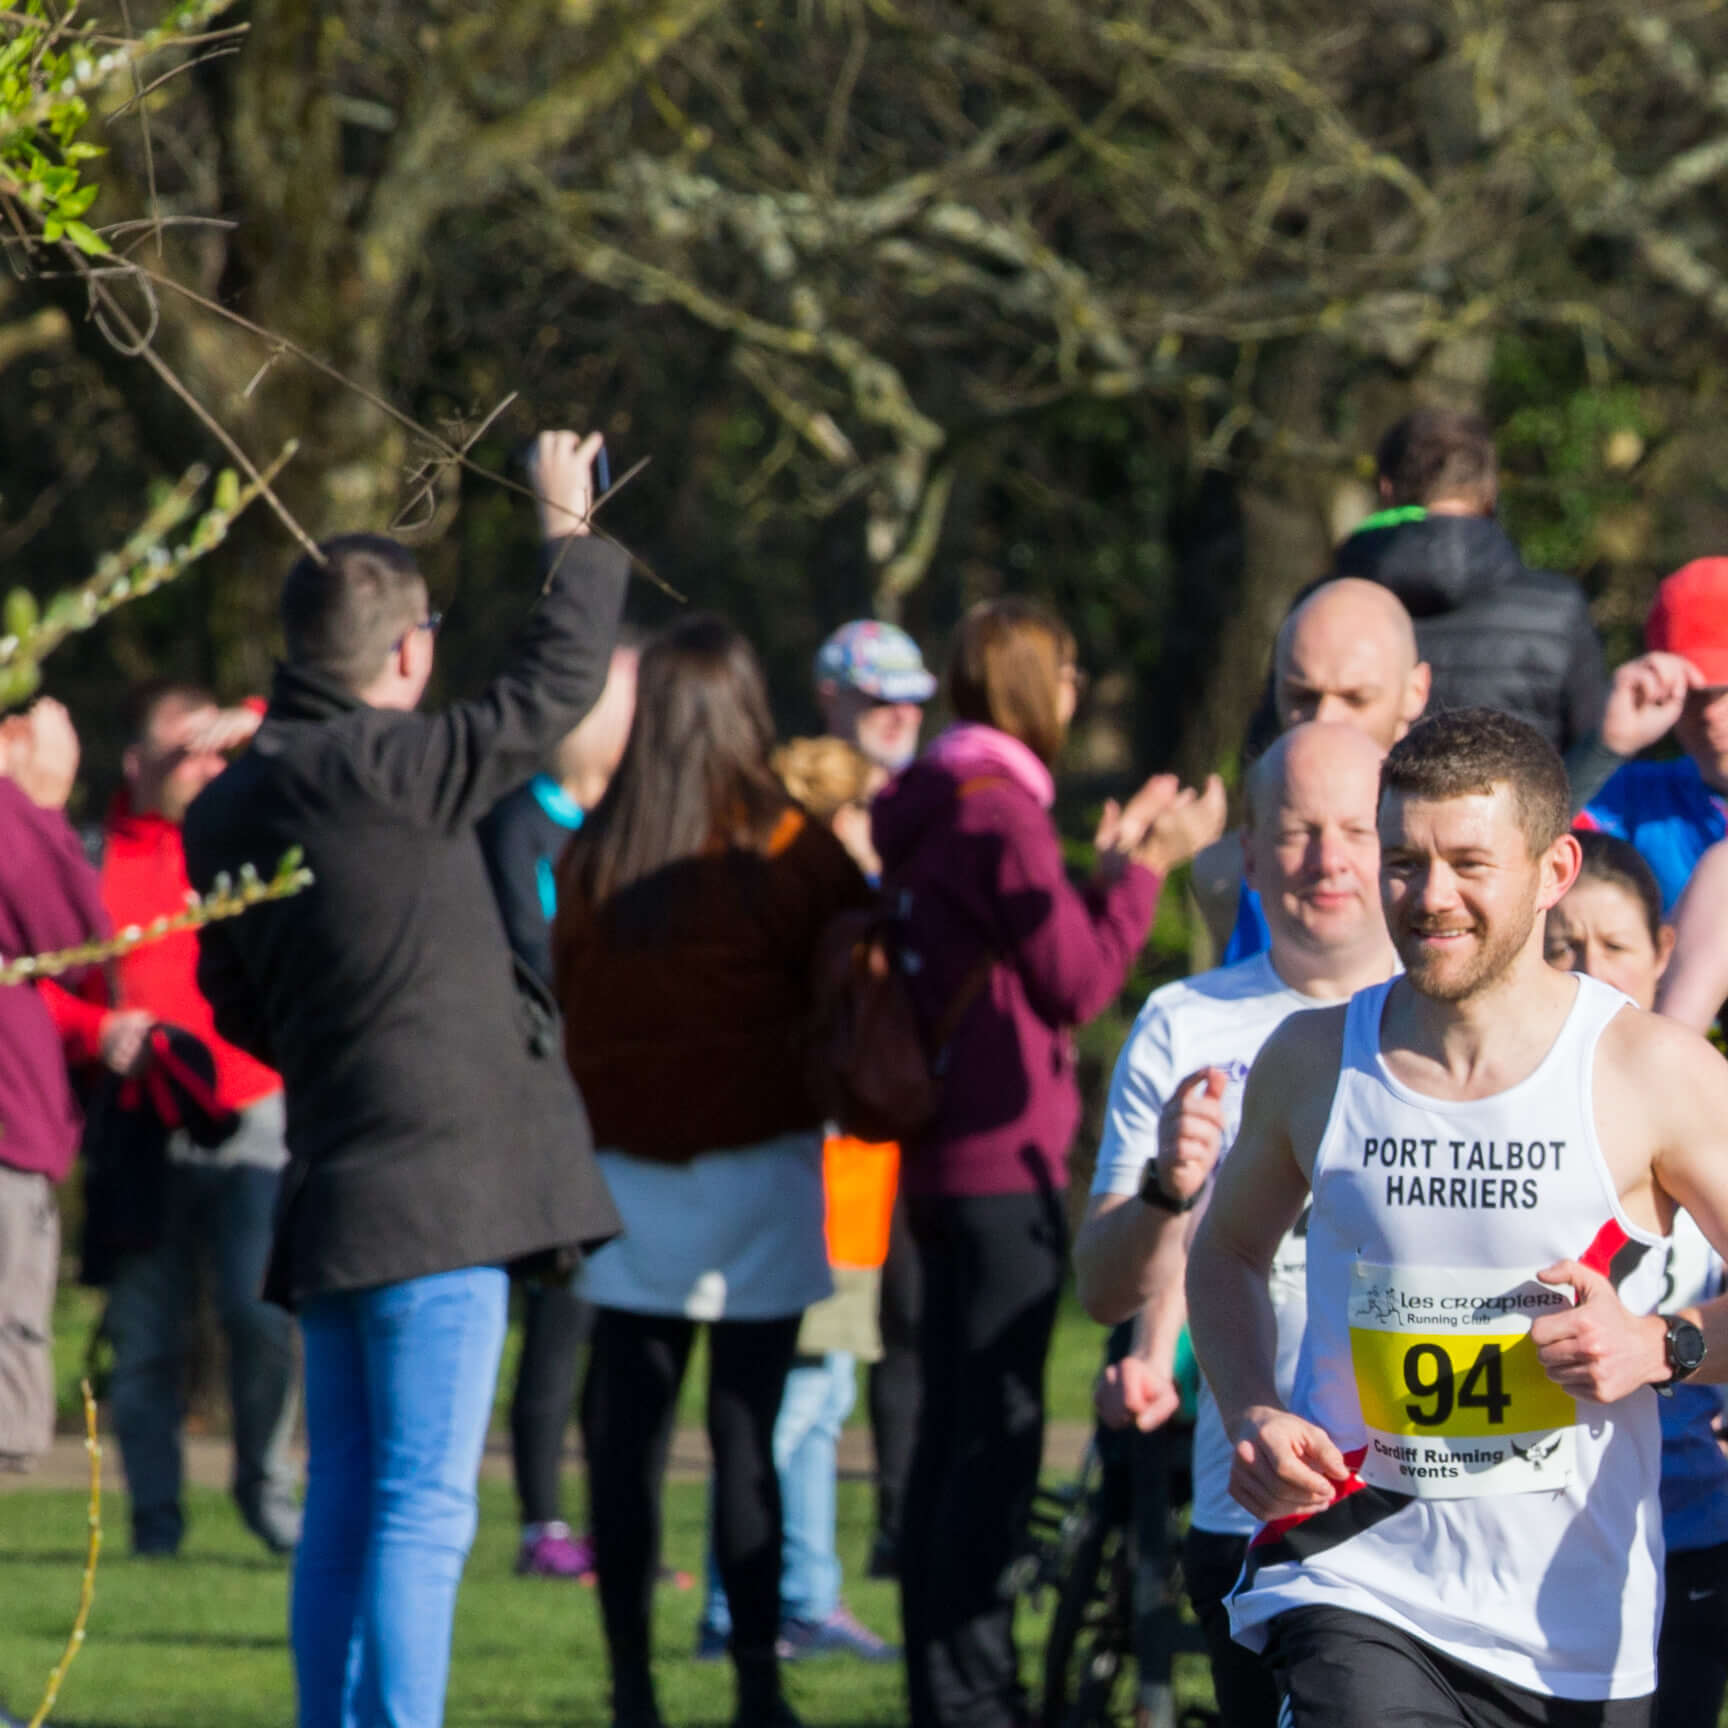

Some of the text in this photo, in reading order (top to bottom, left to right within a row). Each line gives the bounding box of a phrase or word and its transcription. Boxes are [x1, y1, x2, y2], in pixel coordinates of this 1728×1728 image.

[1362, 1137, 1566, 1171] PORT TALBOT
[1386, 1175, 1538, 1210] HARRIERS
[1407, 1314, 1491, 1326] Running Club
[1403, 1343, 1512, 1427] 94
[1374, 1439, 1504, 1466] Cardiff Running
[1400, 1465, 1459, 1478] events
